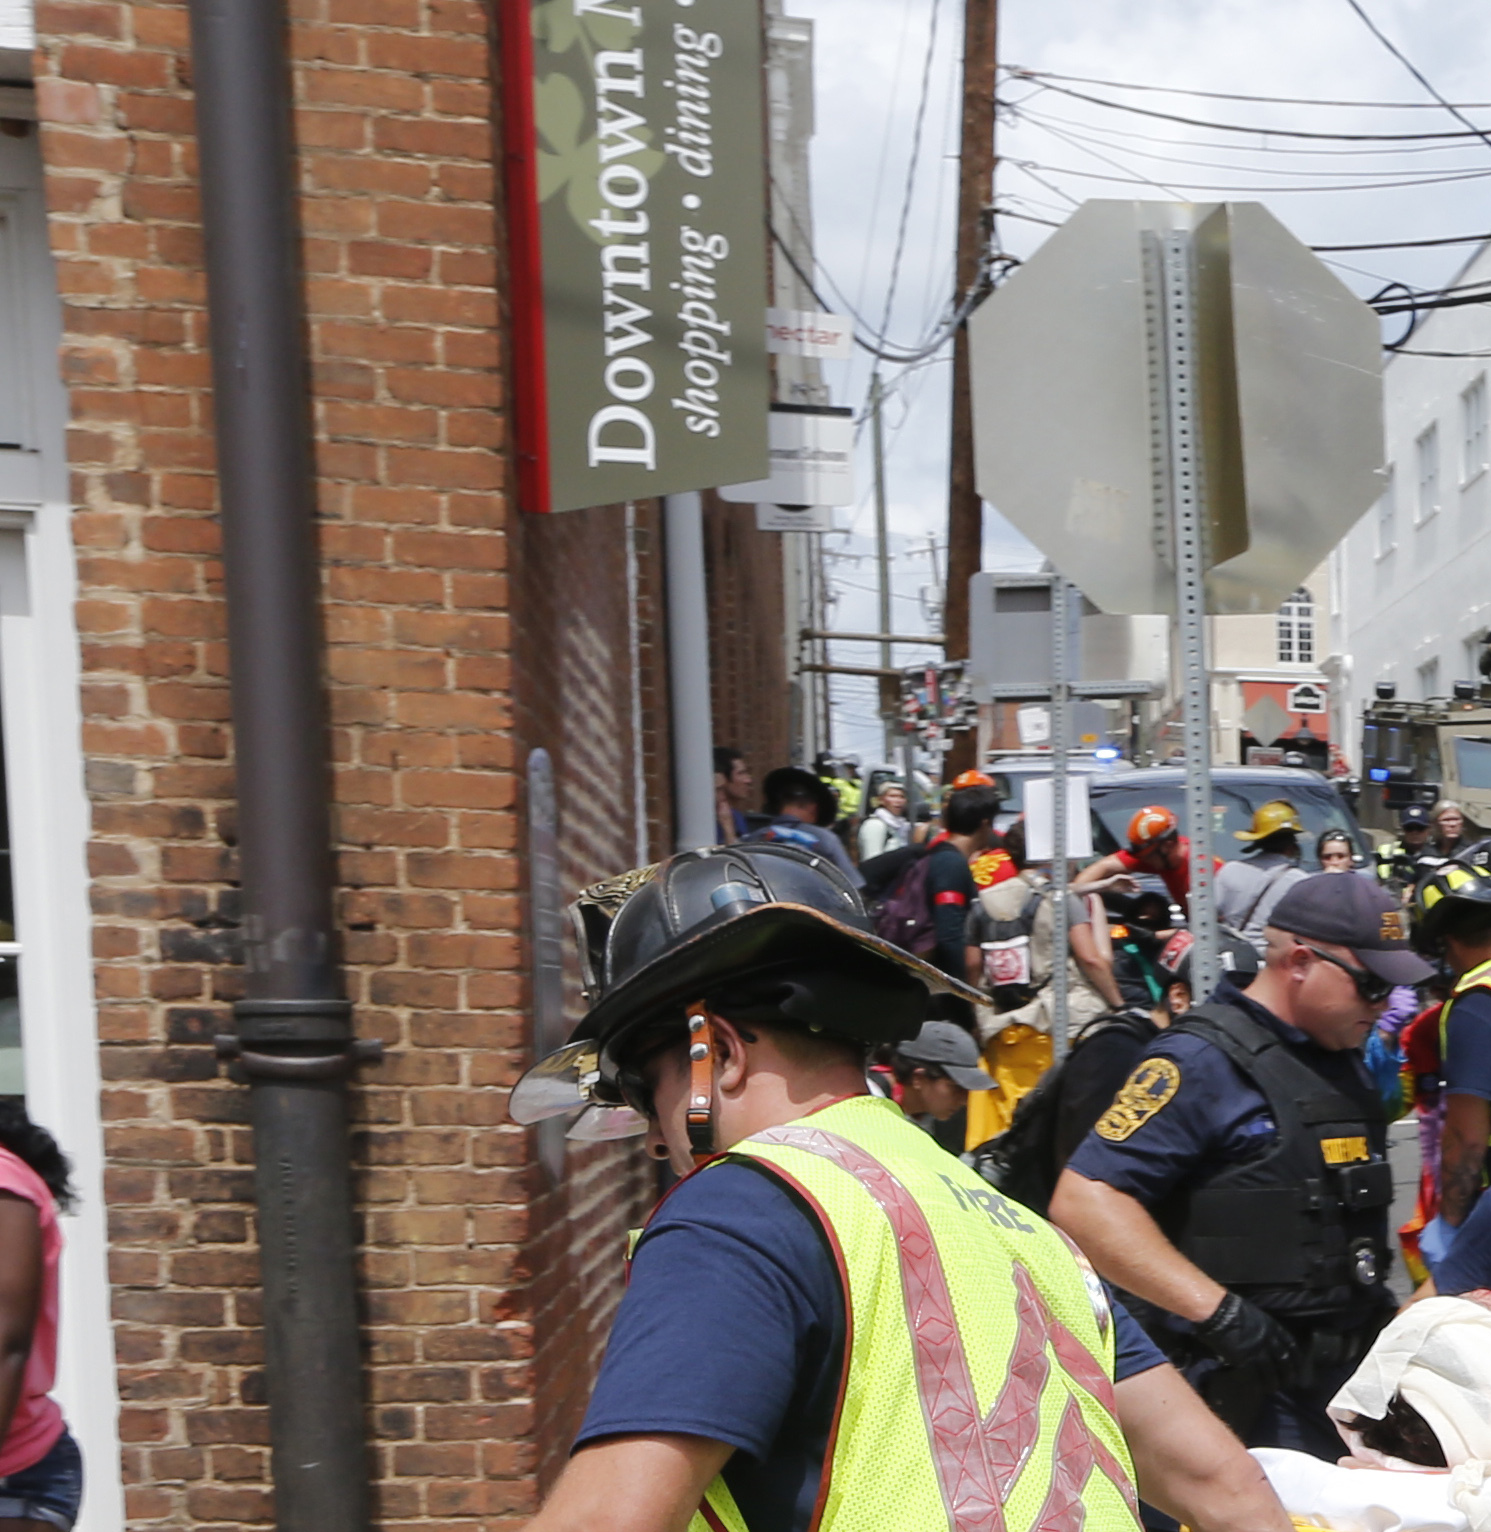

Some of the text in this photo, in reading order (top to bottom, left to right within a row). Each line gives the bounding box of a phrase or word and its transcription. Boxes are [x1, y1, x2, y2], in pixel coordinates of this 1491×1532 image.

[587, 48, 656, 471] Downtown
[663, 23, 732, 438] shopping dining
[935, 1171, 1037, 1234] FIRE
